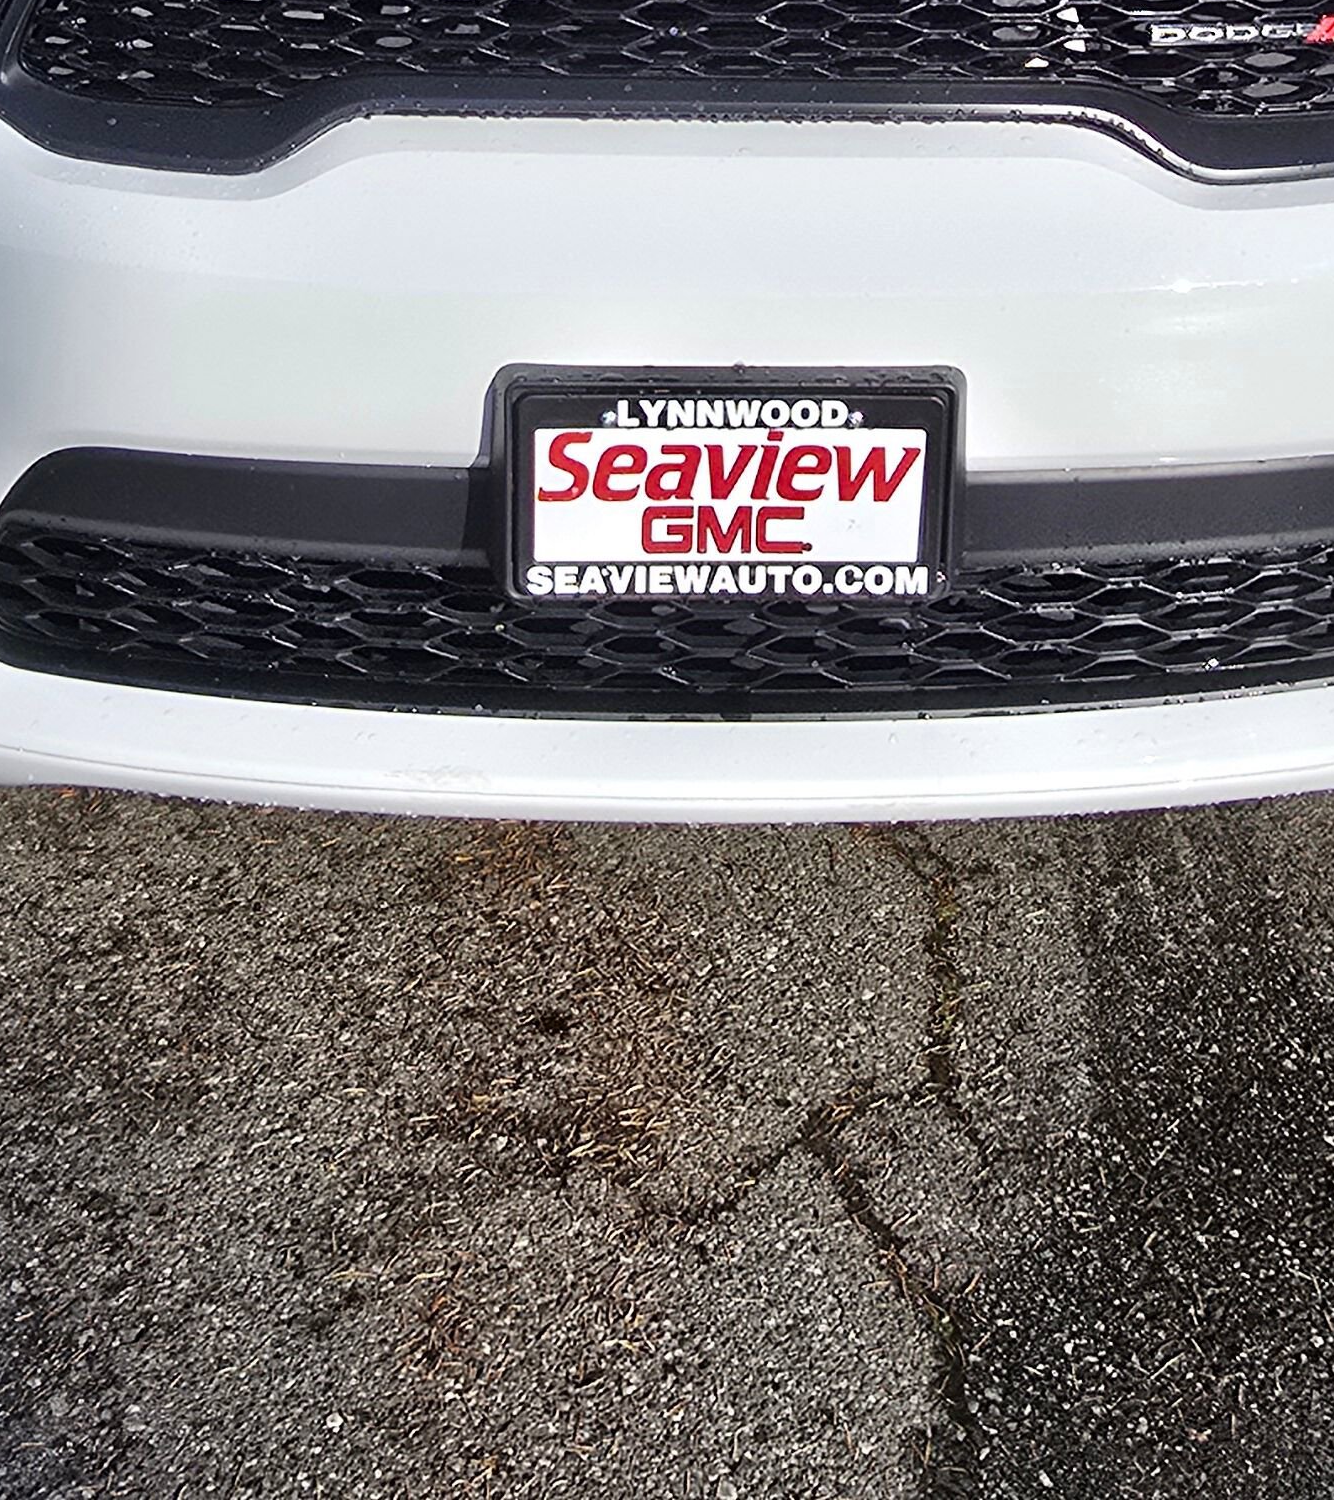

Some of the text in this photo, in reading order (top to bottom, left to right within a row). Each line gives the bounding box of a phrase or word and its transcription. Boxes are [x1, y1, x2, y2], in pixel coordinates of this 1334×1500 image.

[617, 400, 849, 428] LYNNWOOD
[537, 431, 921, 502] Seaview
[641, 506, 812, 554] GMC
[526, 566, 928, 595] SEAVIEWAUTO.COM
